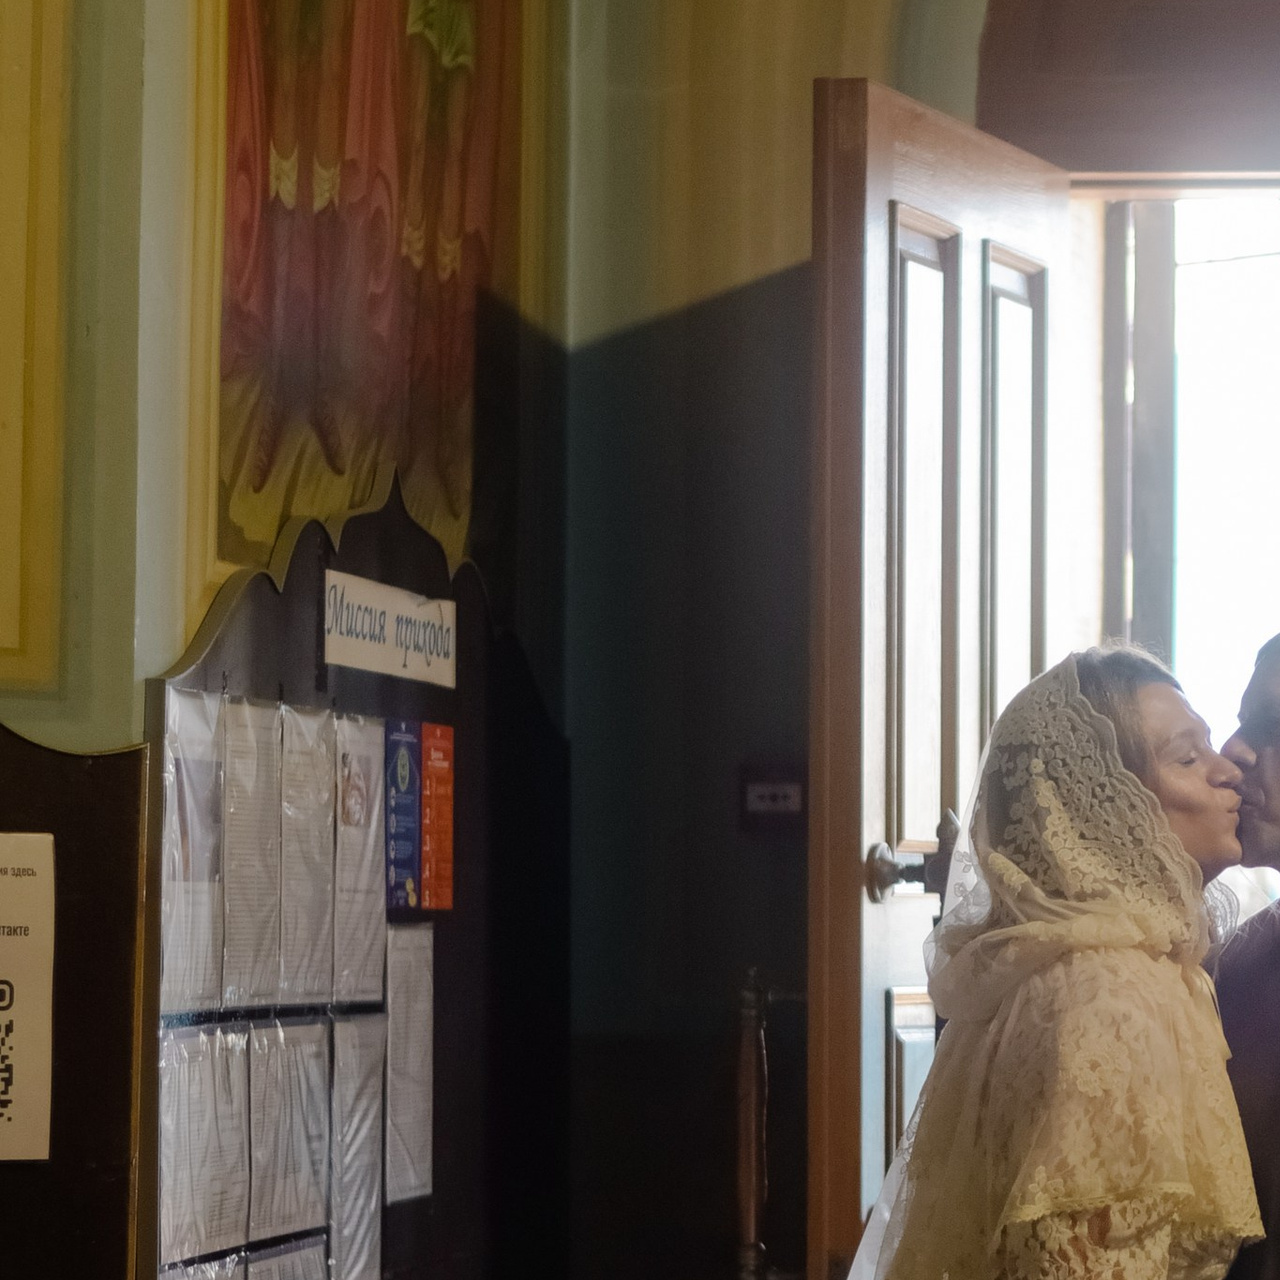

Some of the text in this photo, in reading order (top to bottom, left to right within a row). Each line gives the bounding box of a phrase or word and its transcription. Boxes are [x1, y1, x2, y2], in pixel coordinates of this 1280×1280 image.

[326, 584, 452, 669] Миссия прихода
[10, 867, 37, 878] здесь
[0, 925, 30, 937] такте
